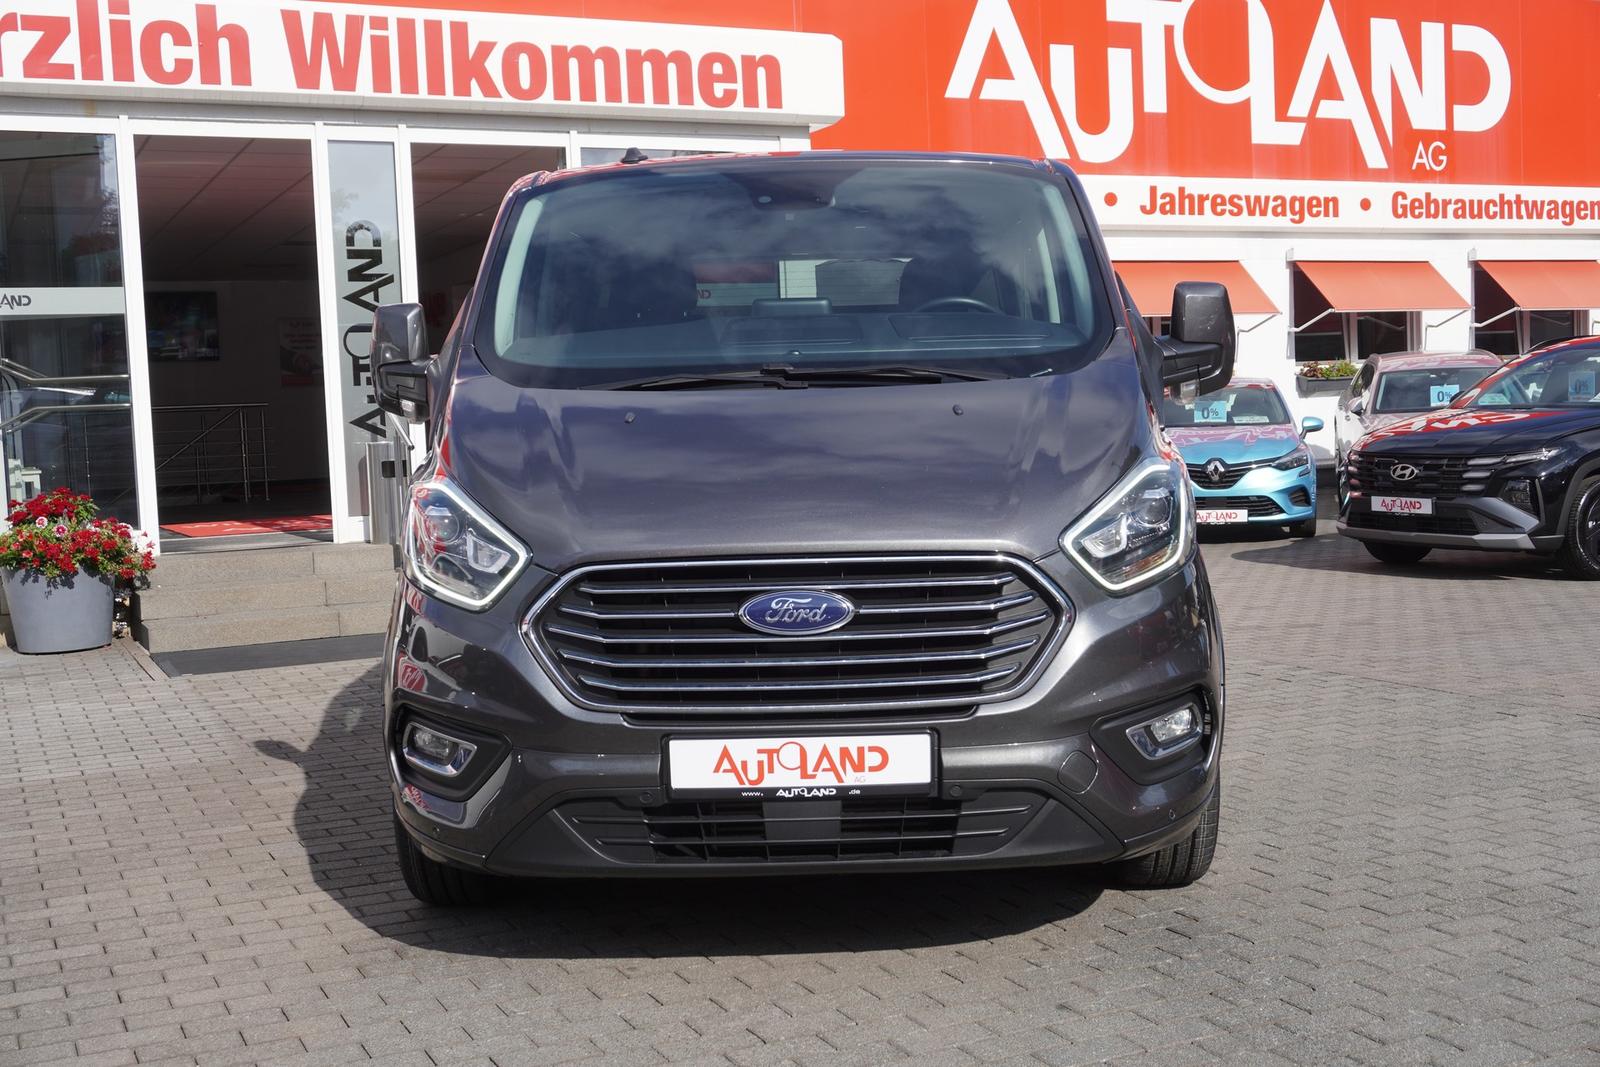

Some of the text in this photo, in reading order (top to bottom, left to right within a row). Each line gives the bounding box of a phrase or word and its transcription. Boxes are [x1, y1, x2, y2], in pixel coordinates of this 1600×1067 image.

[280, 9, 783, 109] Willkommen
[944, 0, 1511, 169] AUTOLAND
[1411, 141, 1447, 172] AG
[1140, 185, 1600, 227] Jahreswagen Gebrauchtwagen
[1202, 407, 1219, 419] 0%
[1381, 497, 1422, 512] AUTOLAND
[765, 597, 826, 624] Ford
[713, 741, 889, 786] AUTOLAND
[776, 787, 837, 797] AUTOLAND
